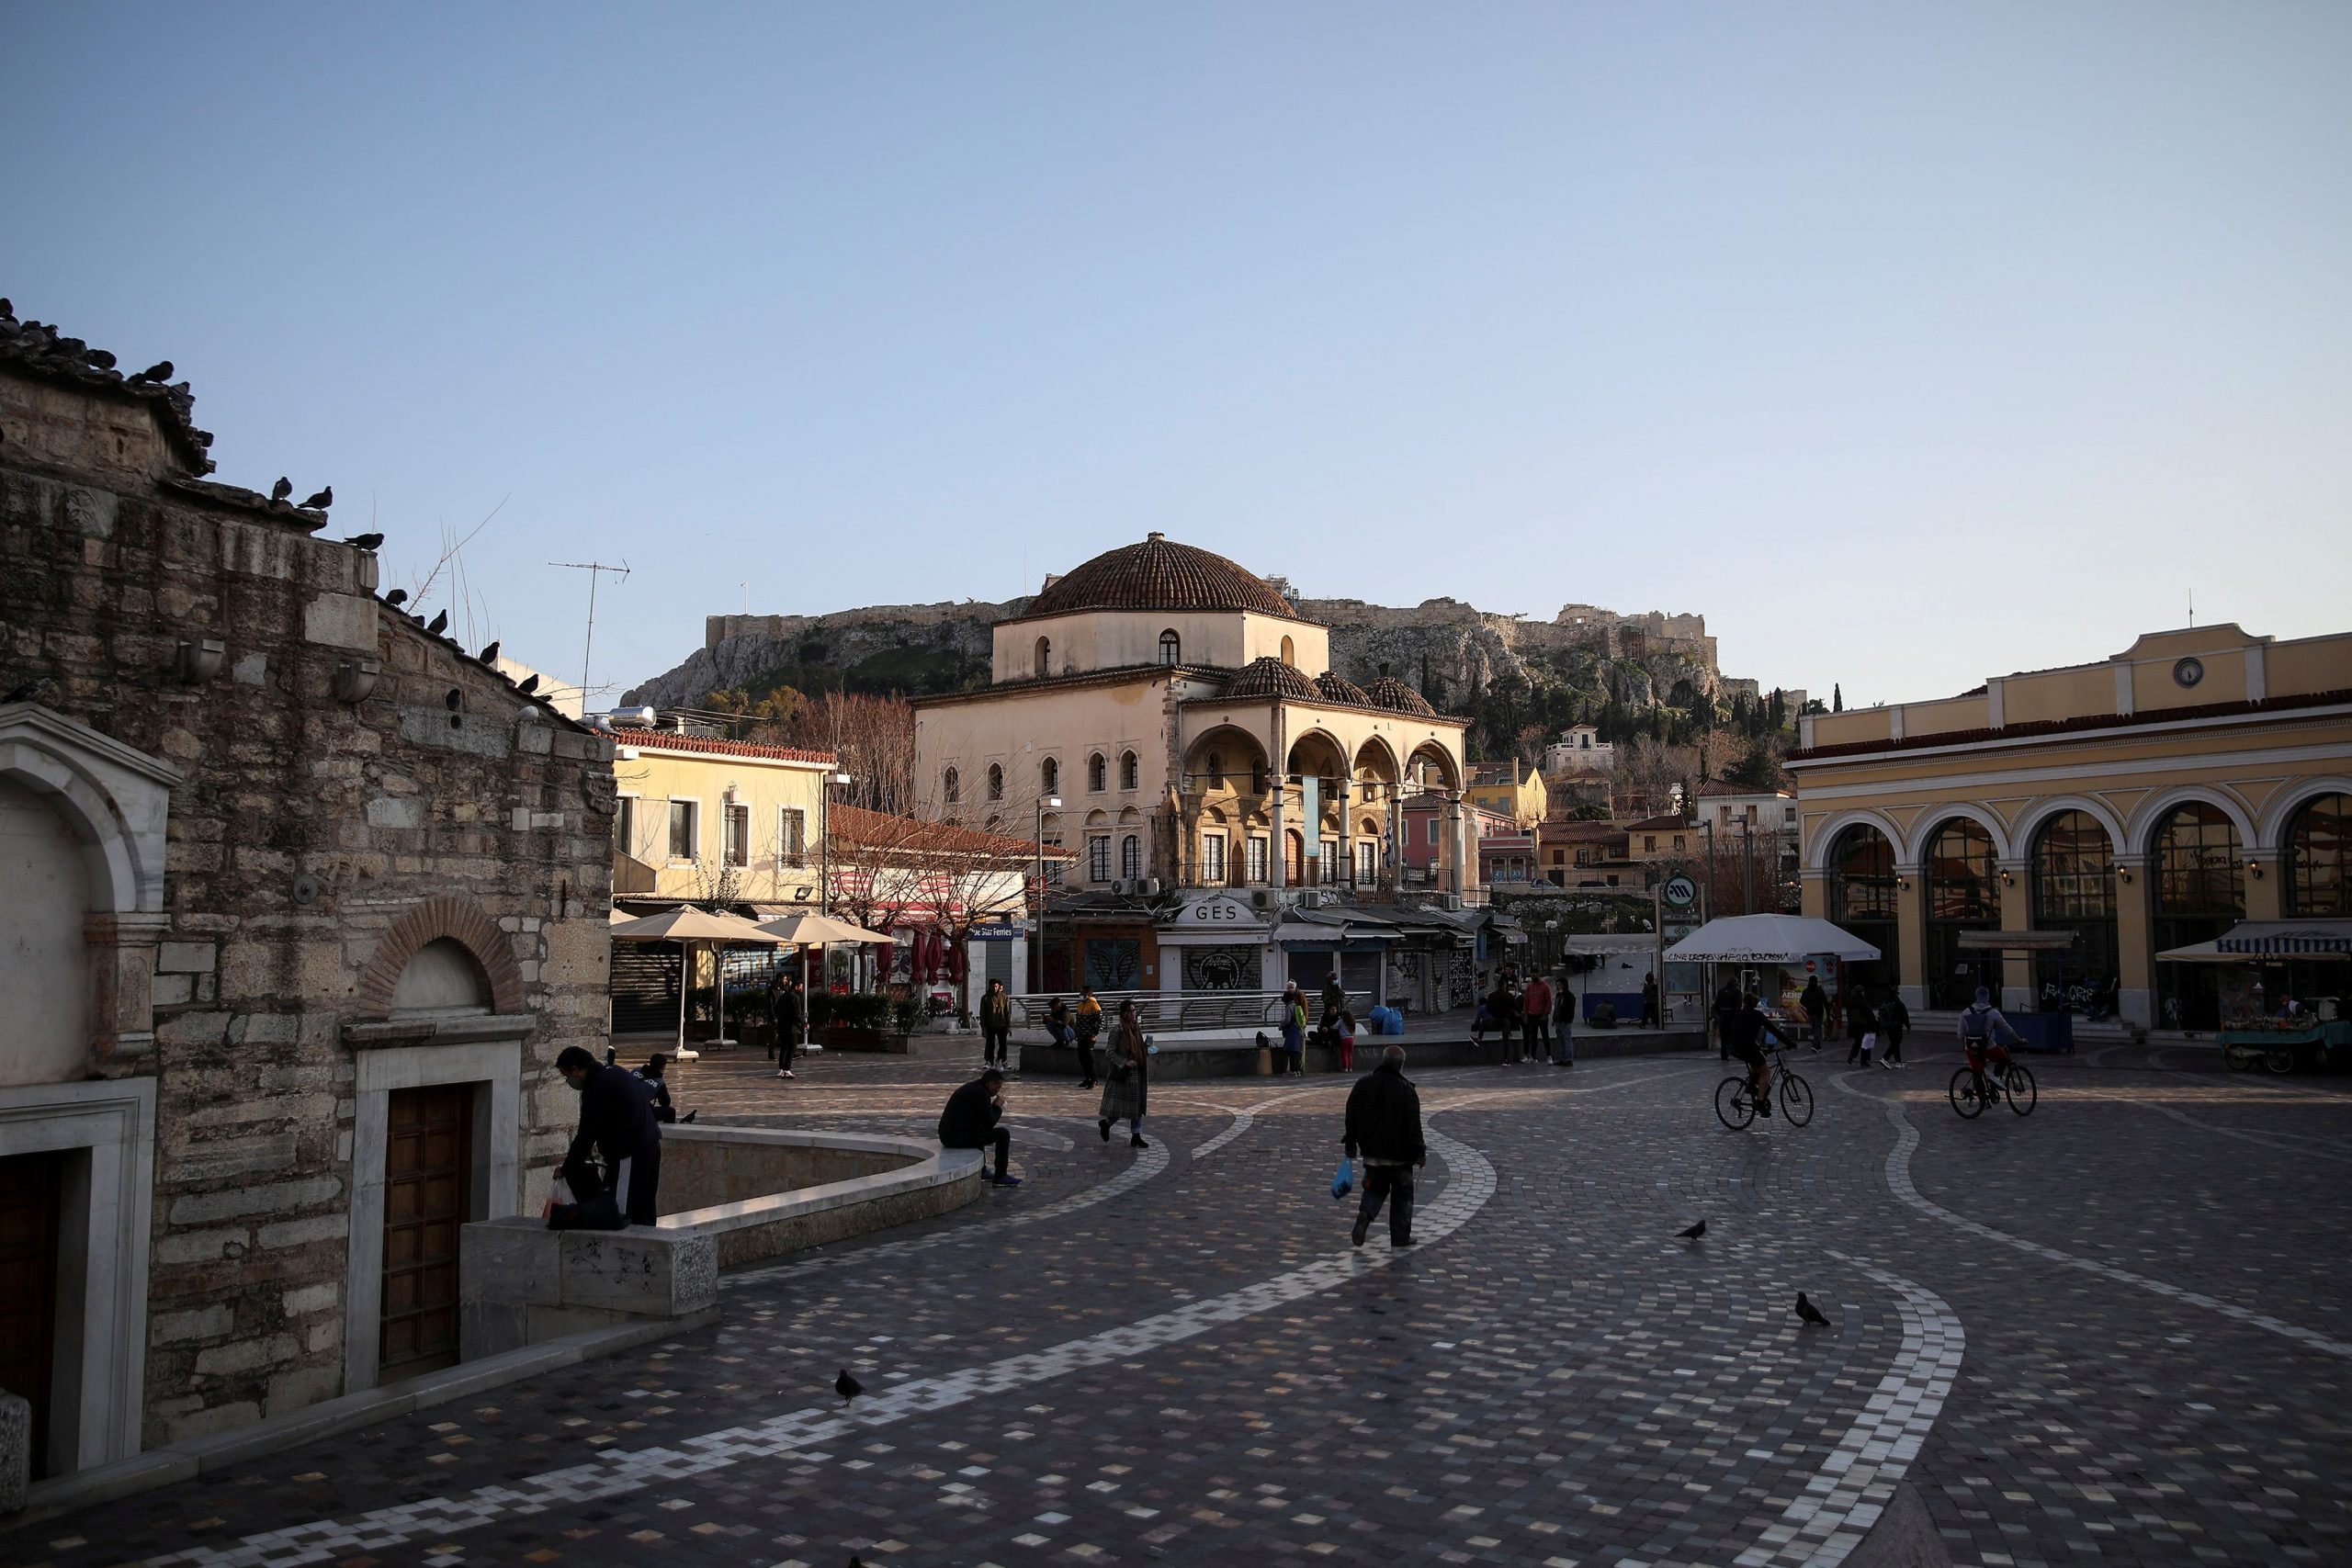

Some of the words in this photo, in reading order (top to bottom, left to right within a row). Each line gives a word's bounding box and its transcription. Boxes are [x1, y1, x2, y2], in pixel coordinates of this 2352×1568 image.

[1196, 906, 1237, 919] GES
[981, 928, 992, 936] Star
[993, 928, 1012, 936] Ferries
